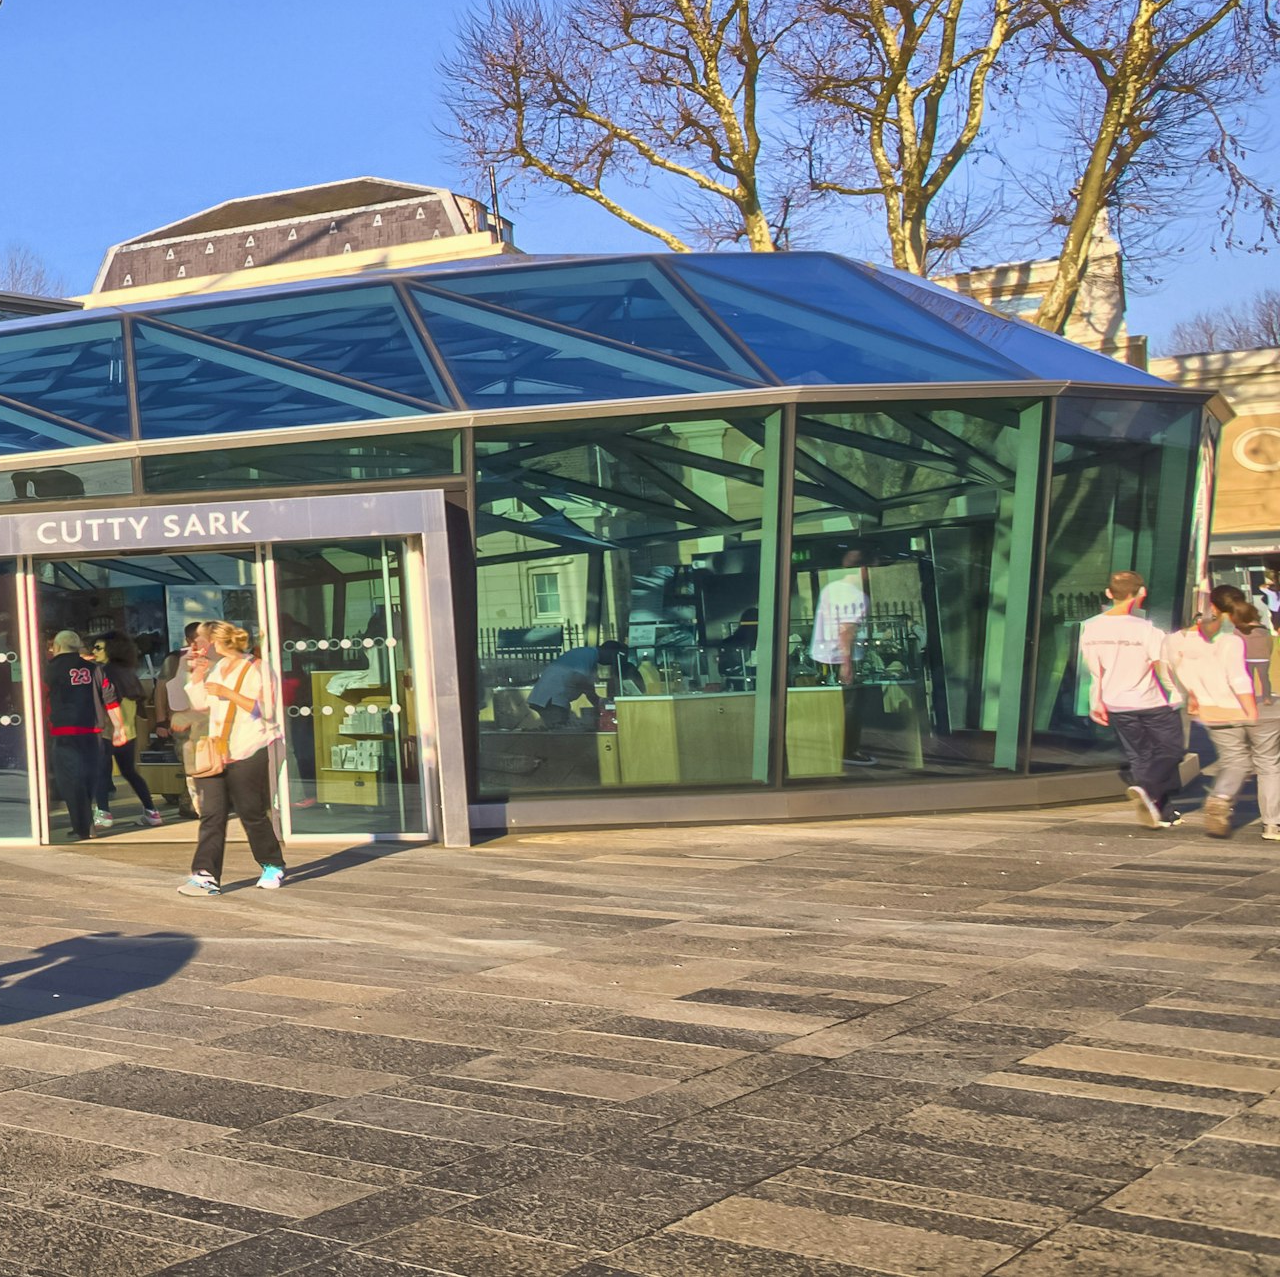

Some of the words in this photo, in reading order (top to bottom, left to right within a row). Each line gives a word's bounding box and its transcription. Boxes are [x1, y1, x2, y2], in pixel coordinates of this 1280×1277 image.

[37, 516, 149, 544] CUTTY
[163, 510, 252, 538] SARK
[69, 668, 92, 685] 23
